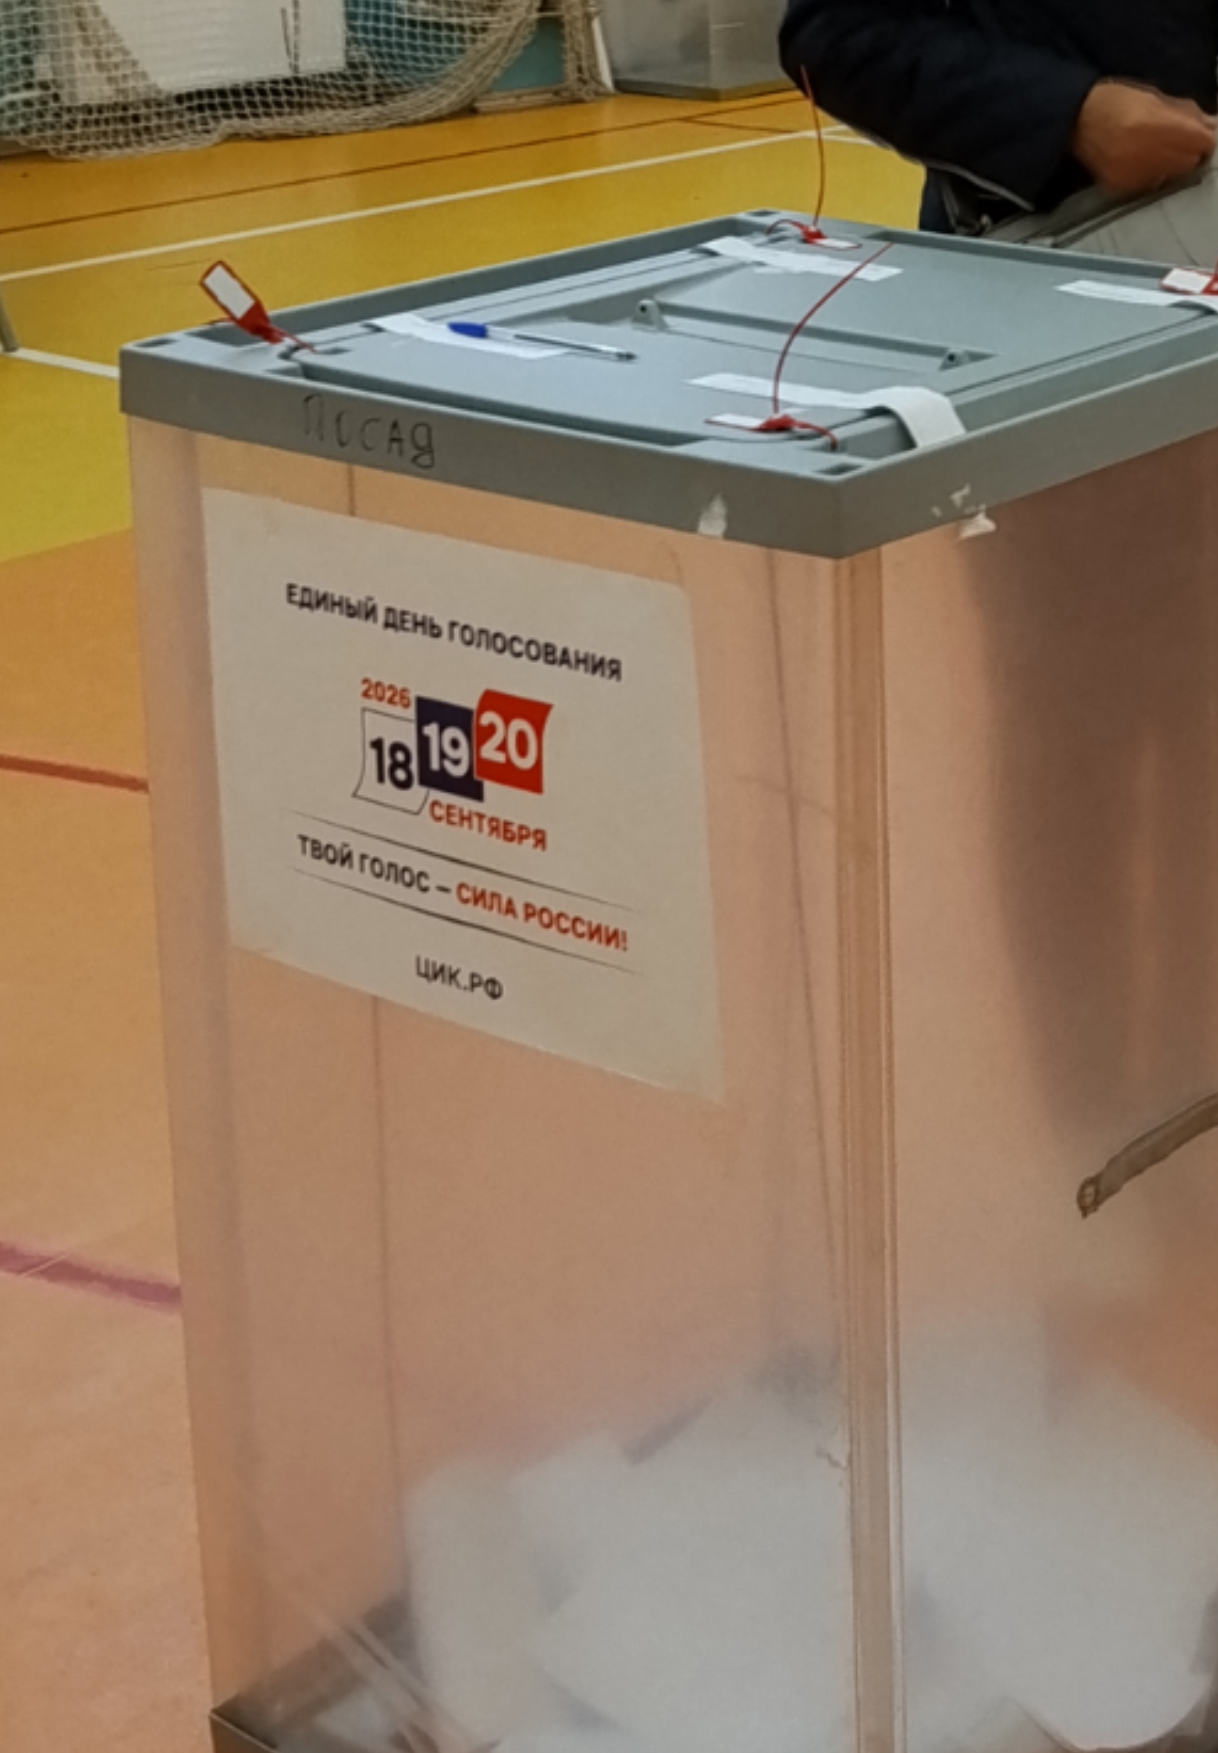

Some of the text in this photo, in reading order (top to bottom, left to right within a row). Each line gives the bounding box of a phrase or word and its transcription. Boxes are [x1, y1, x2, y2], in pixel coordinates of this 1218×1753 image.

[286, 583, 623, 681] ЕДИНЫЙ ДЕНЬ ГОЛОСОВАНИЯ
[361, 678, 411, 708] 2026
[370, 711, 538, 791] 18 19 20
[429, 800, 547, 851] СЕНТЯБРЯ
[297, 834, 354, 871] ТВОЙ
[359, 855, 430, 893] ГОЛОС
[456, 883, 519, 919] СИЛА
[523, 904, 629, 951] РОССИИ!
[415, 956, 504, 1000] ЦИК.РФ
